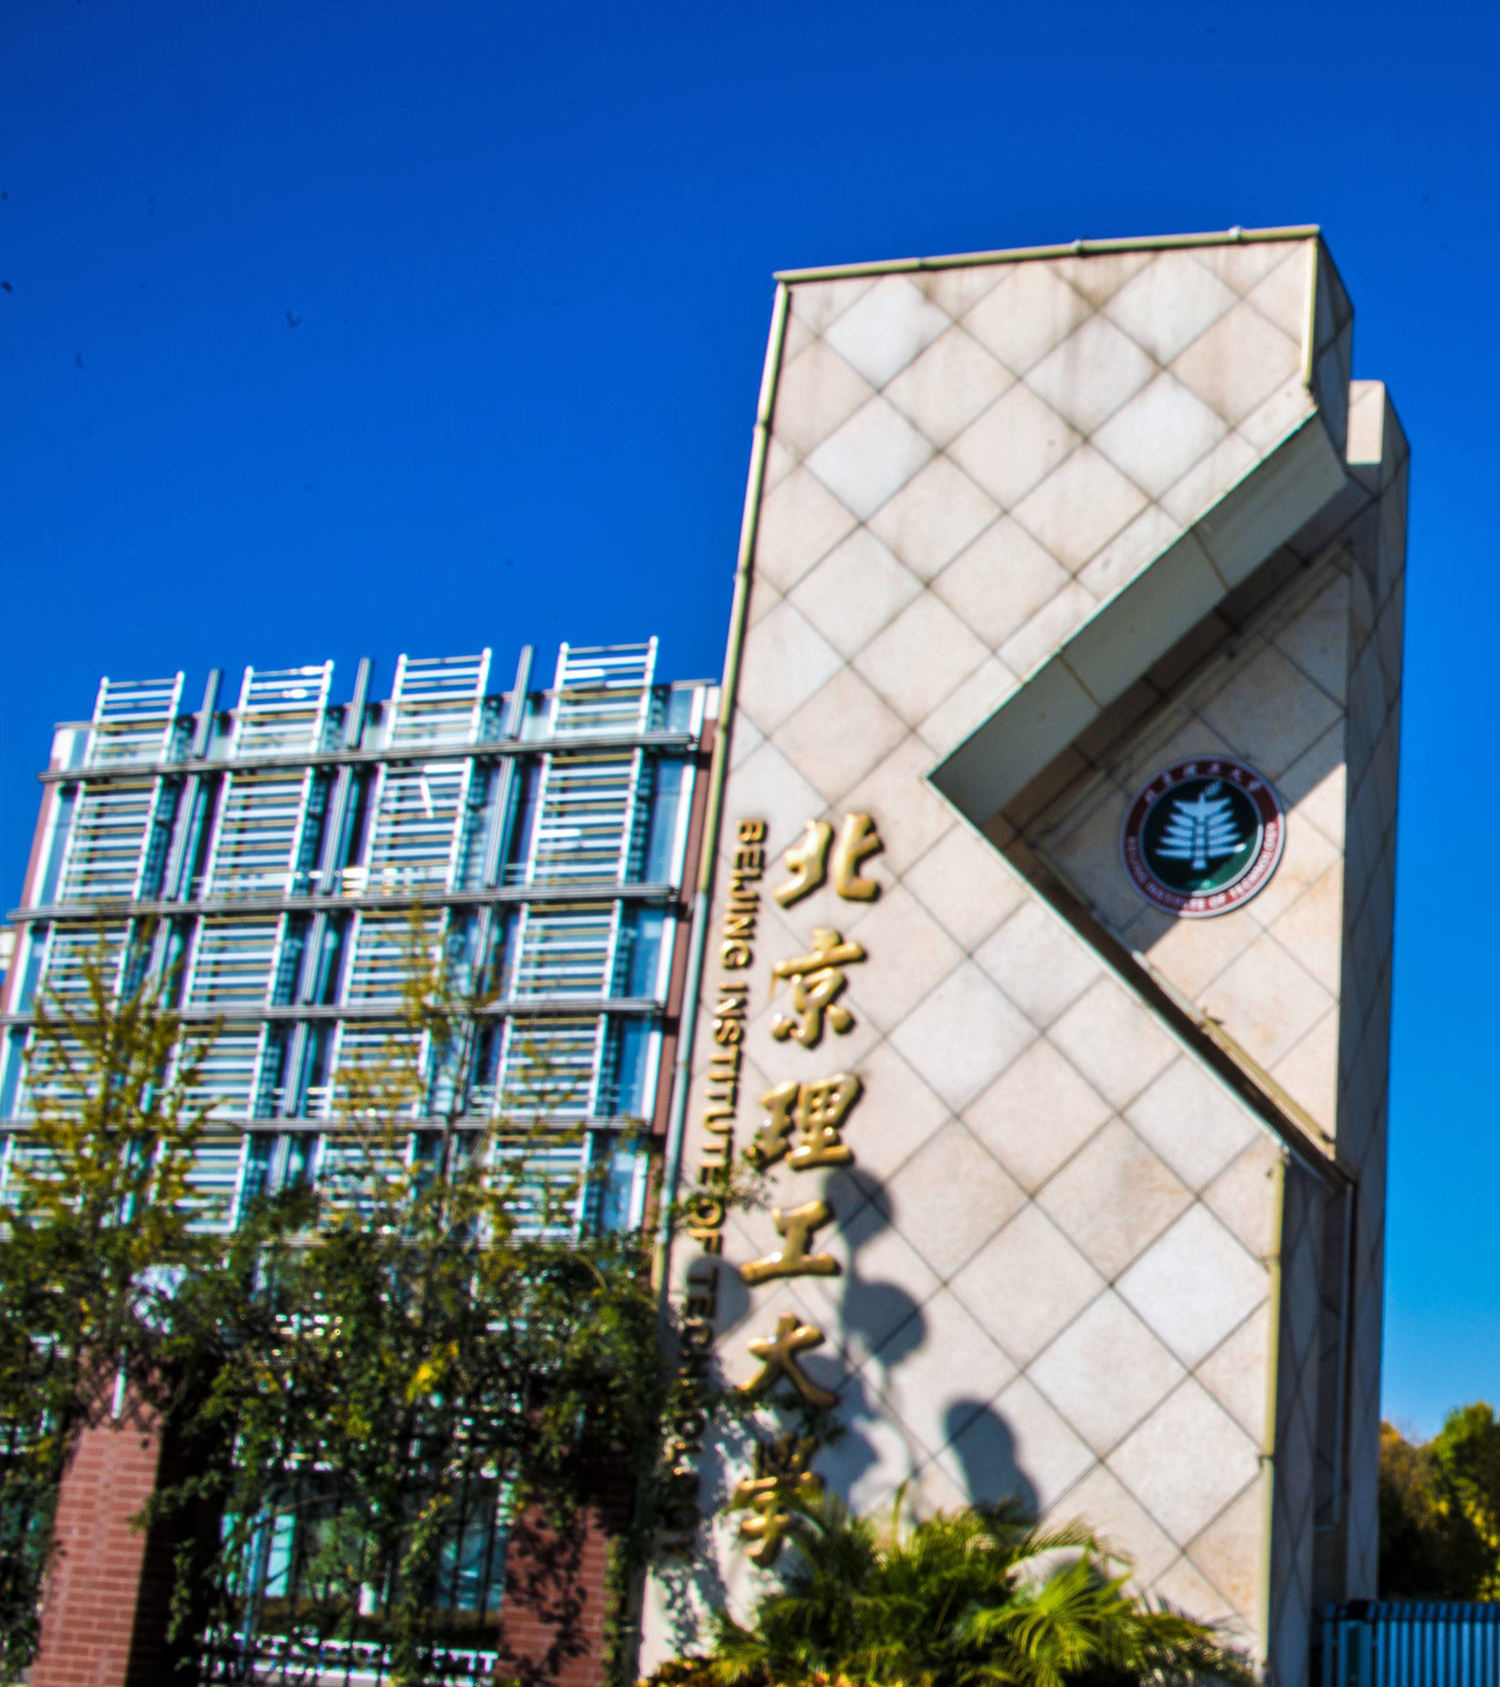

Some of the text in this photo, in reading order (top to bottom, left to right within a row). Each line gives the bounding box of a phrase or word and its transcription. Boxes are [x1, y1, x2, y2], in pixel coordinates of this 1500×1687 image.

[662, 819, 767, 1562] BEIJING INSTITUTE OF TECHOLY
